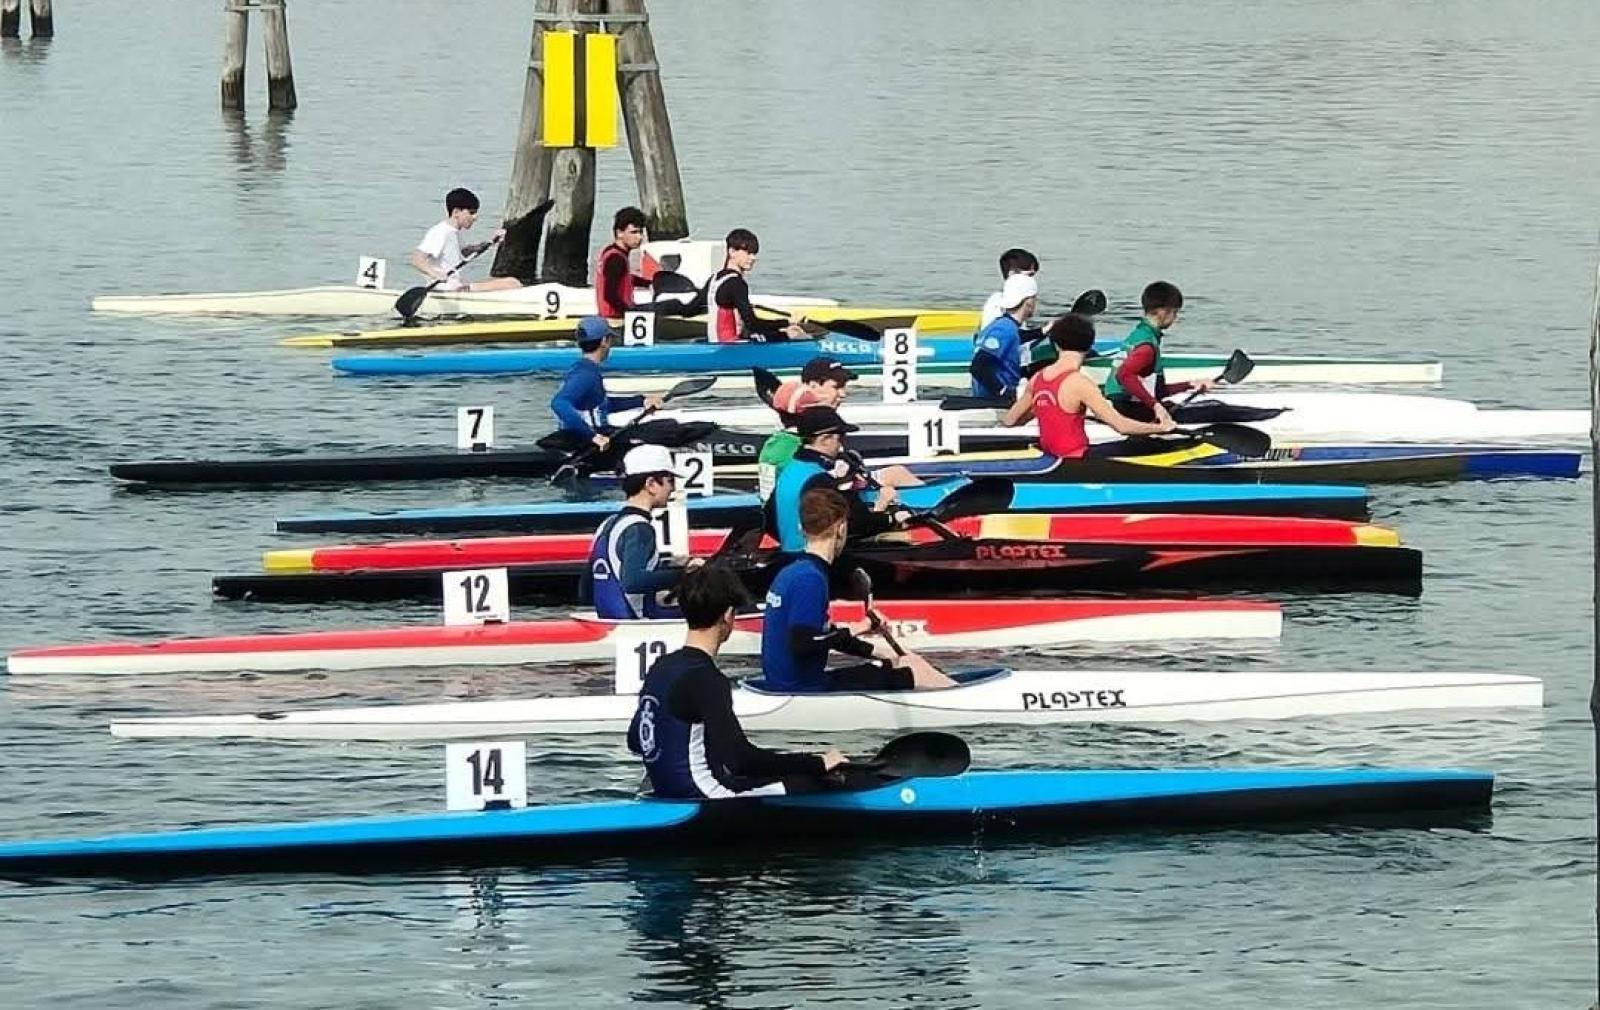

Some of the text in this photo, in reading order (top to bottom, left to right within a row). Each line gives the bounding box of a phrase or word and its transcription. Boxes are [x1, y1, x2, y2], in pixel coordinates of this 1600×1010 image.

[364, 261, 378, 281] 4
[546, 291, 560, 314] 9
[632, 315, 647, 339] 6
[894, 332, 909, 355] 8
[891, 368, 909, 395] 3
[467, 408, 484, 439] 7
[923, 418, 943, 447] 11
[696, 442, 757, 454] NELO
[684, 457, 704, 489] 2
[656, 510, 672, 545] 1
[460, 574, 490, 613] 12
[466, 748, 504, 795] 14
